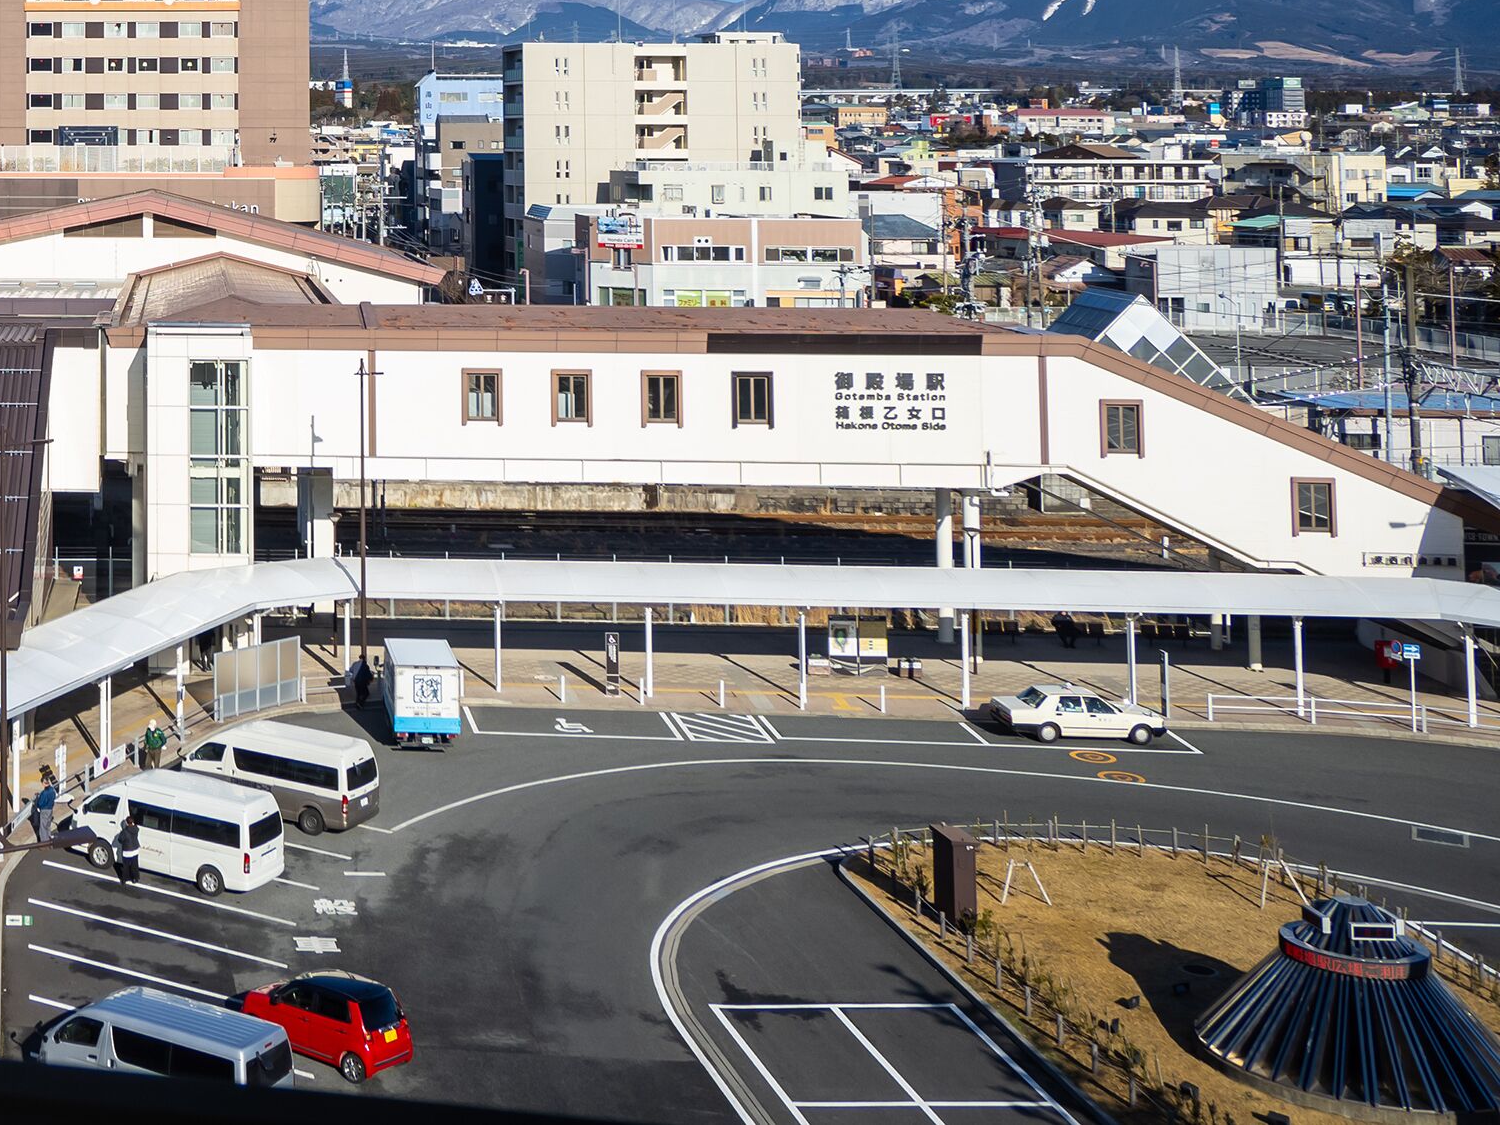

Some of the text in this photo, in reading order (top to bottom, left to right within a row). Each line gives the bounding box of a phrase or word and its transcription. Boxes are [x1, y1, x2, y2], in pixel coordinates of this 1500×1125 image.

[835, 372, 945, 391] 御殿場駅
[835, 392, 946, 401] Gotemba Station
[835, 405, 945, 420] 箱根乙女口
[836, 421, 946, 430] Hakone Otome Side
